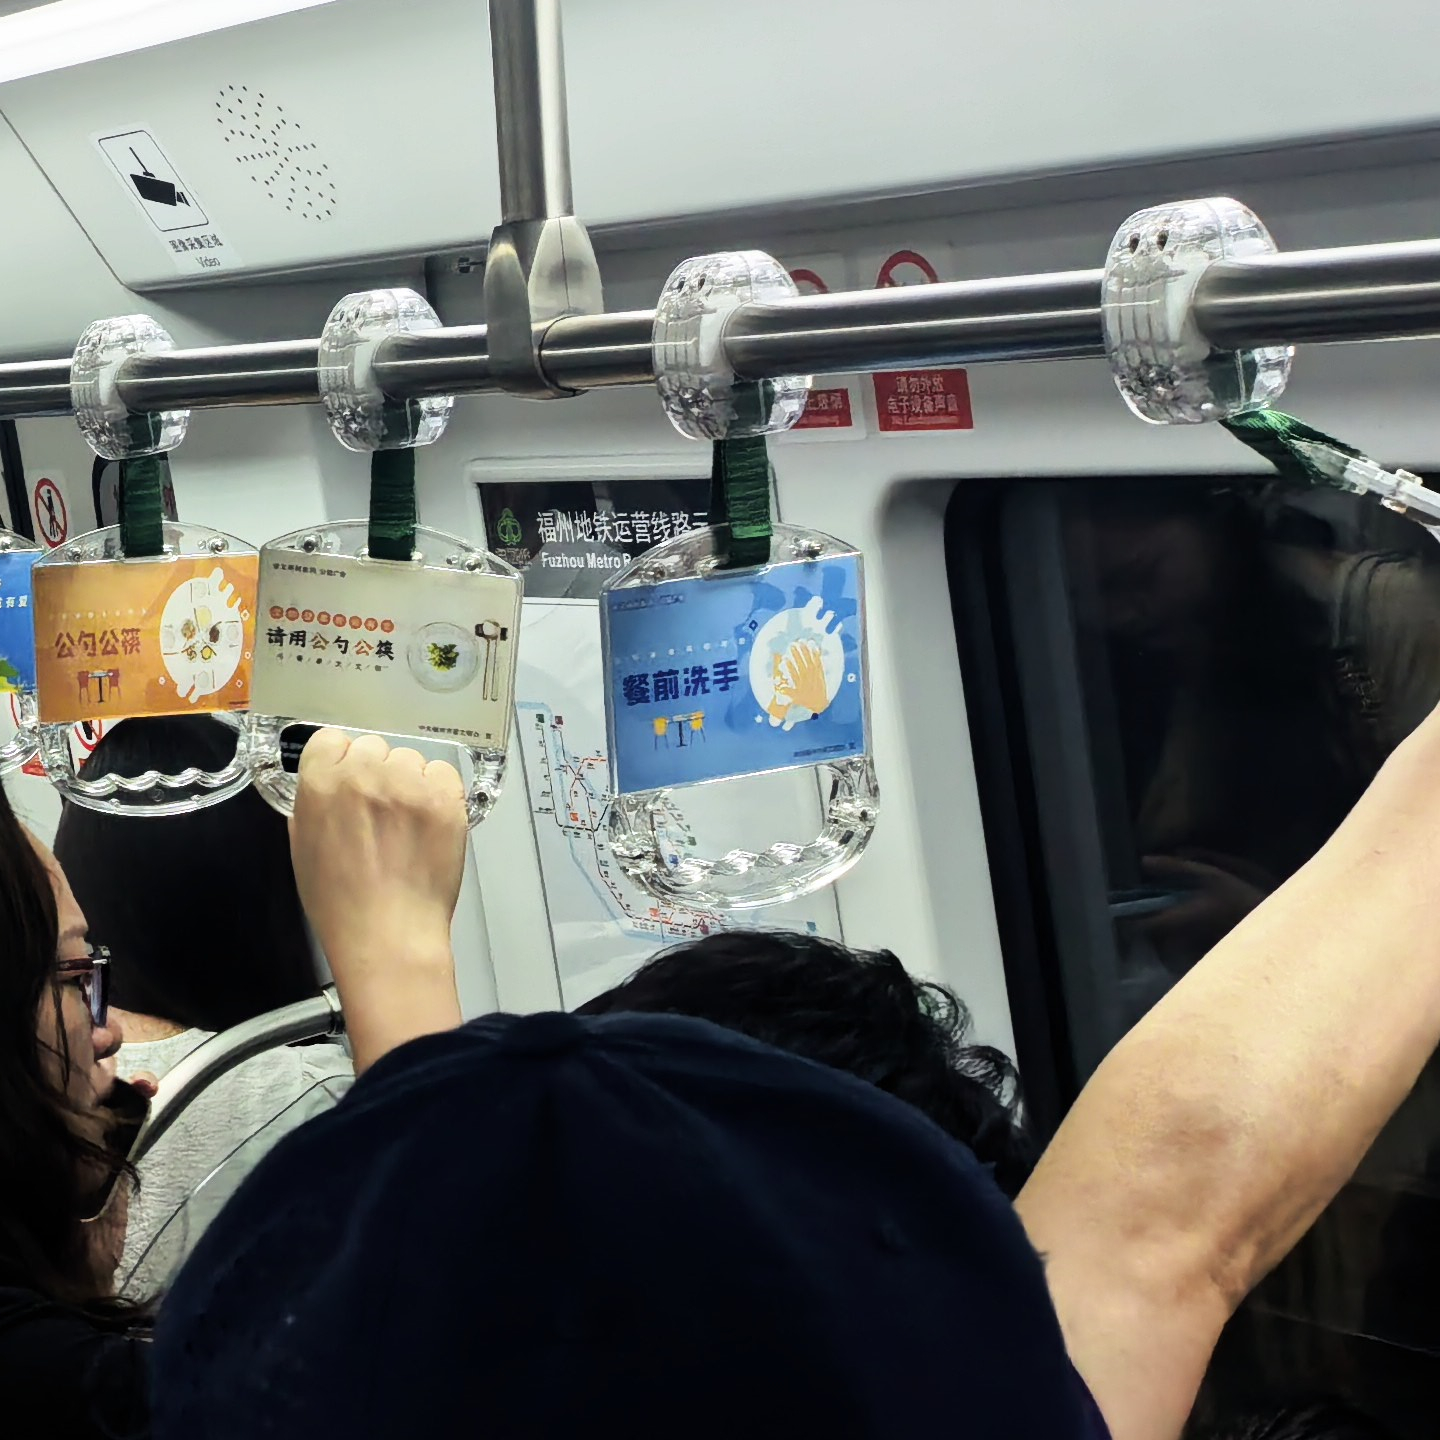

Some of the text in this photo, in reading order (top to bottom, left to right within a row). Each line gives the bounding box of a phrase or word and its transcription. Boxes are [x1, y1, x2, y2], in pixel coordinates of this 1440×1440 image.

[541, 551, 584, 569] Fuzhou
[586, 552, 622, 569] Metro
[54, 627, 141, 659] 公勺公筷
[266, 626, 395, 661] 请用公勺公筷
[622, 659, 739, 706] 餐前洗手
